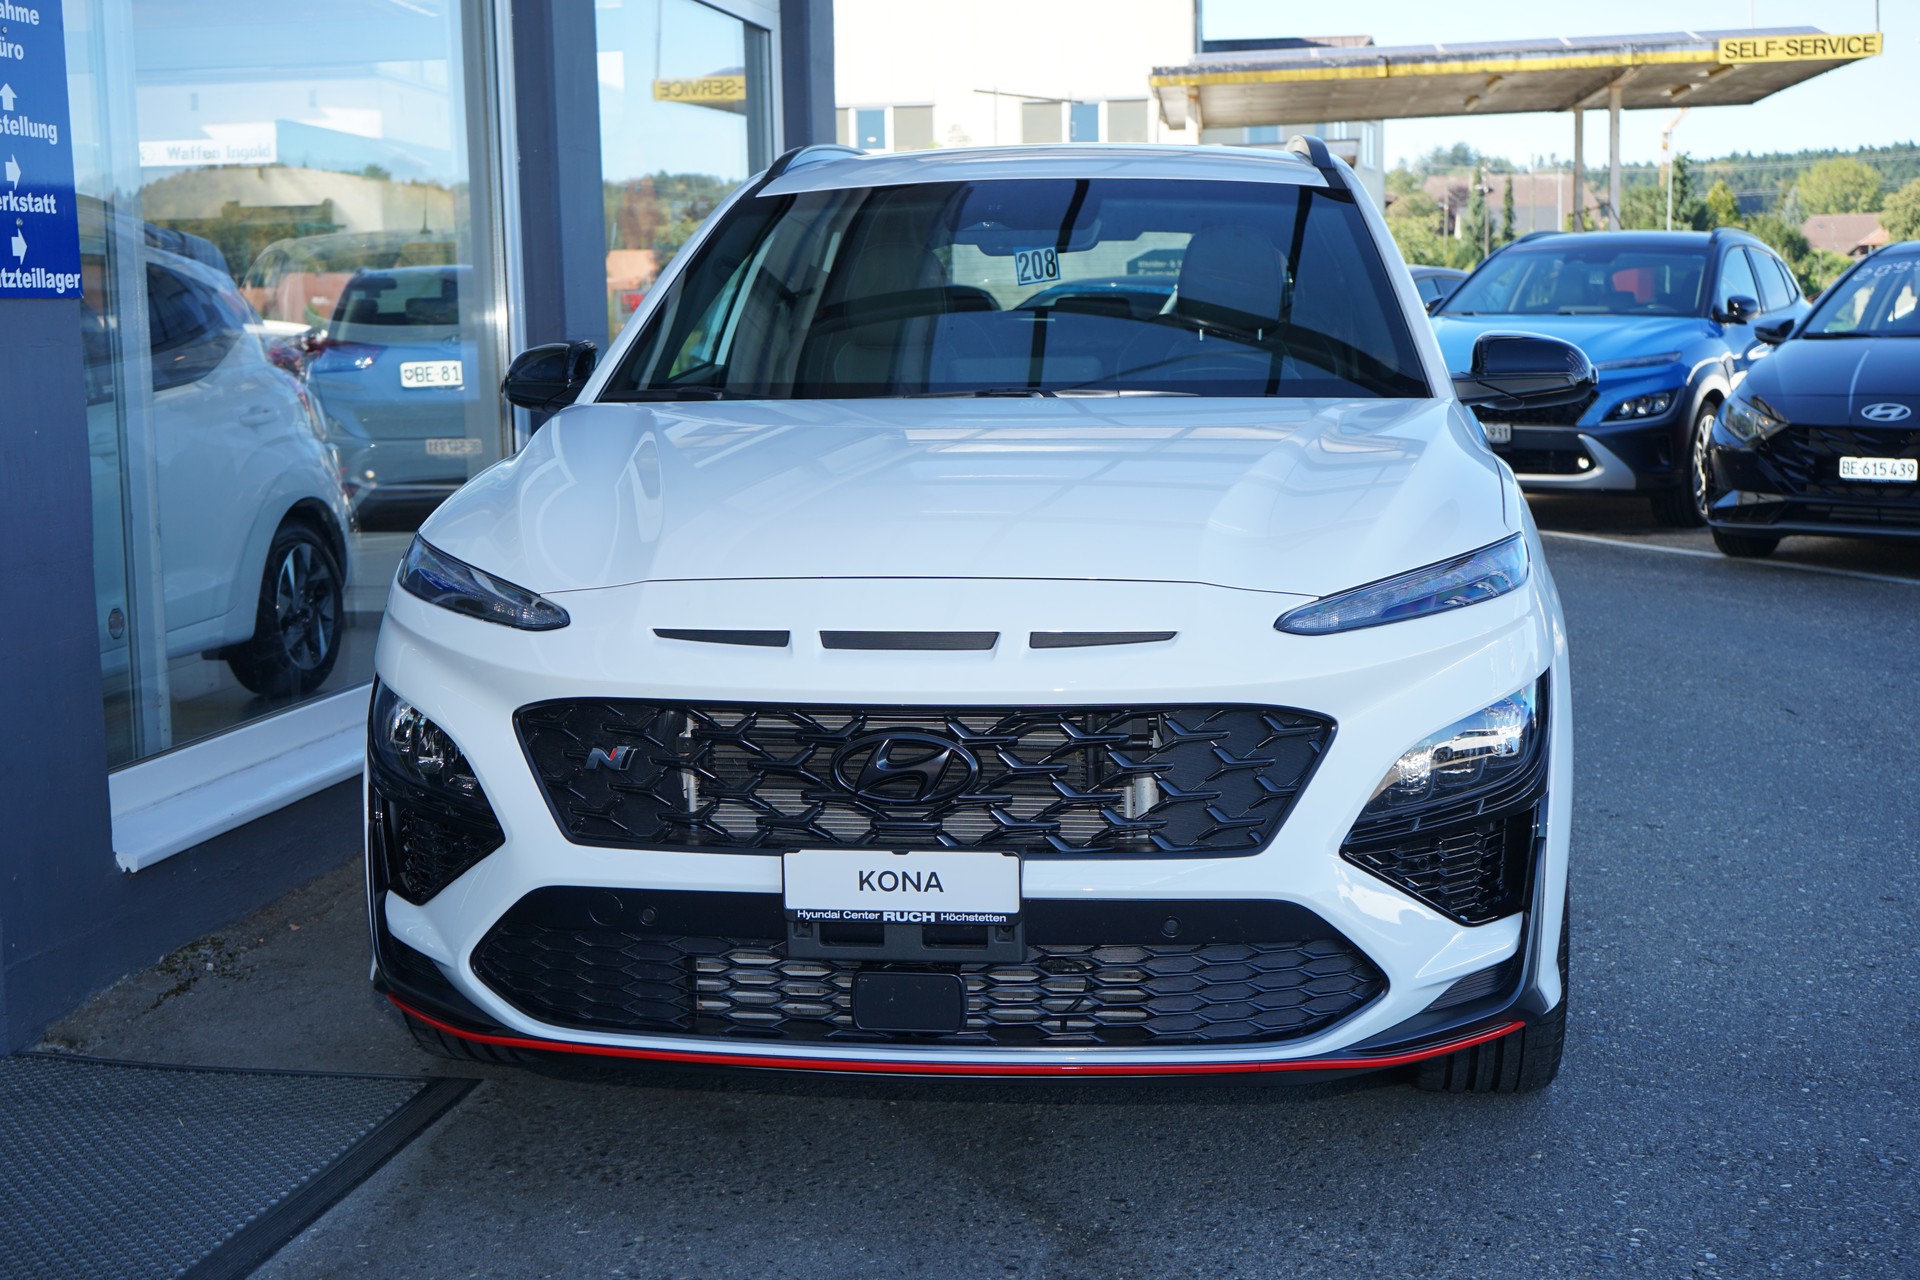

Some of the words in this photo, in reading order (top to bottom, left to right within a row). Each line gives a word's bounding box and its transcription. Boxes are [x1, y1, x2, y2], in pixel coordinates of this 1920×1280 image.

[1725, 36, 1876, 59] SELF-SERVICE
[166, 146, 220, 160] Waffen
[0, 191, 57, 214] rkstatt
[1018, 248, 1057, 282] 208
[0, 267, 81, 294] tzteillager
[858, 870, 945, 893] KONA
[797, 909, 841, 921] Hyundai
[843, 910, 880, 921] Center
[883, 911, 935, 923] RUCH
[940, 912, 1007, 923] Höchstetten
